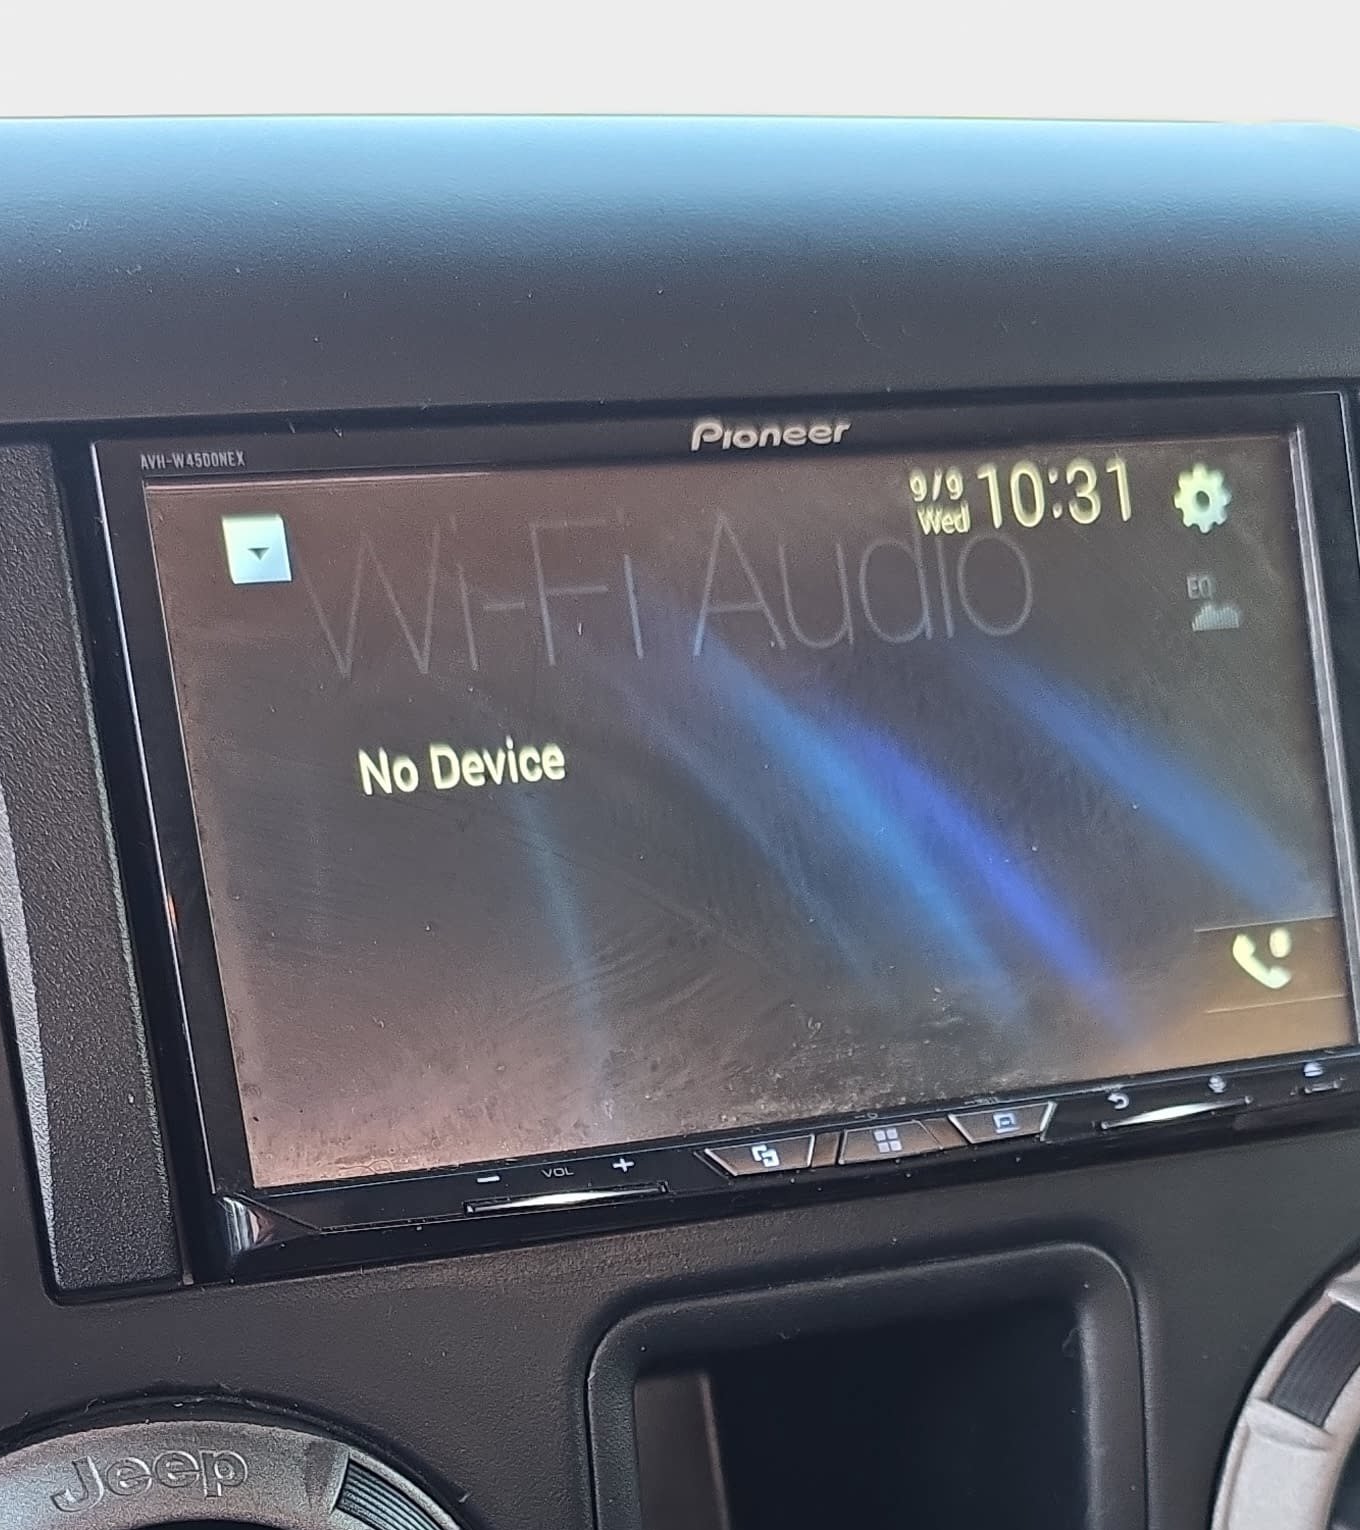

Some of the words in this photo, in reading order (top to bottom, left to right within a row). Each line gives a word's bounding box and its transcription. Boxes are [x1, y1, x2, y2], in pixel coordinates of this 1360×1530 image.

[690, 421, 852, 451] Pioneer
[140, 450, 246, 470] AVH-W4500NEX
[909, 467, 964, 502] 9/9
[977, 456, 1133, 529] 10:31
[917, 502, 971, 535] Wed
[294, 508, 644, 680] Wi-Fi
[692, 505, 1034, 660] Audio
[358, 748, 419, 796] No
[430, 736, 566, 791] Device
[542, 1167, 574, 1179] VOL
[51, 1447, 248, 1513] Jeep
